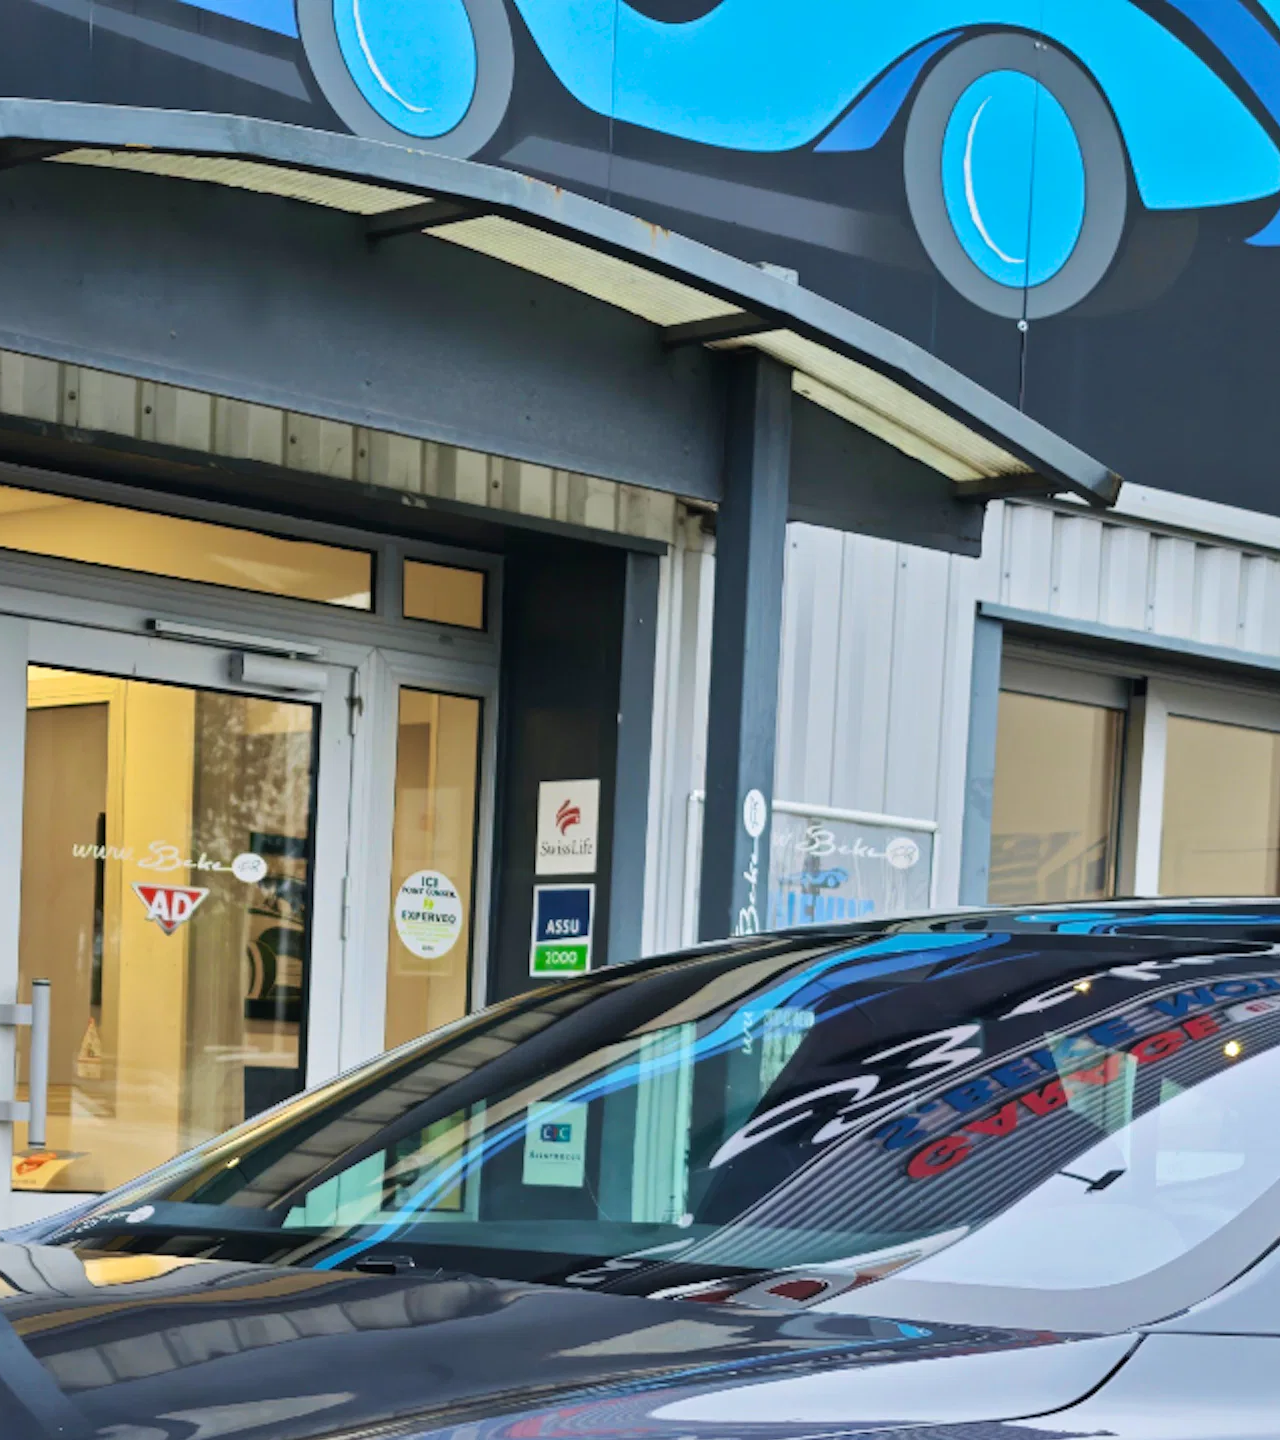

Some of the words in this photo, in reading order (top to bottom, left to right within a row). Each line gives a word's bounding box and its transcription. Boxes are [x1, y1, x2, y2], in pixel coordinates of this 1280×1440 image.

[540, 838, 593, 857] SwissLife
[421, 876, 439, 888] ICI
[145, 889, 194, 922] AD
[545, 918, 581, 935] ASSU
